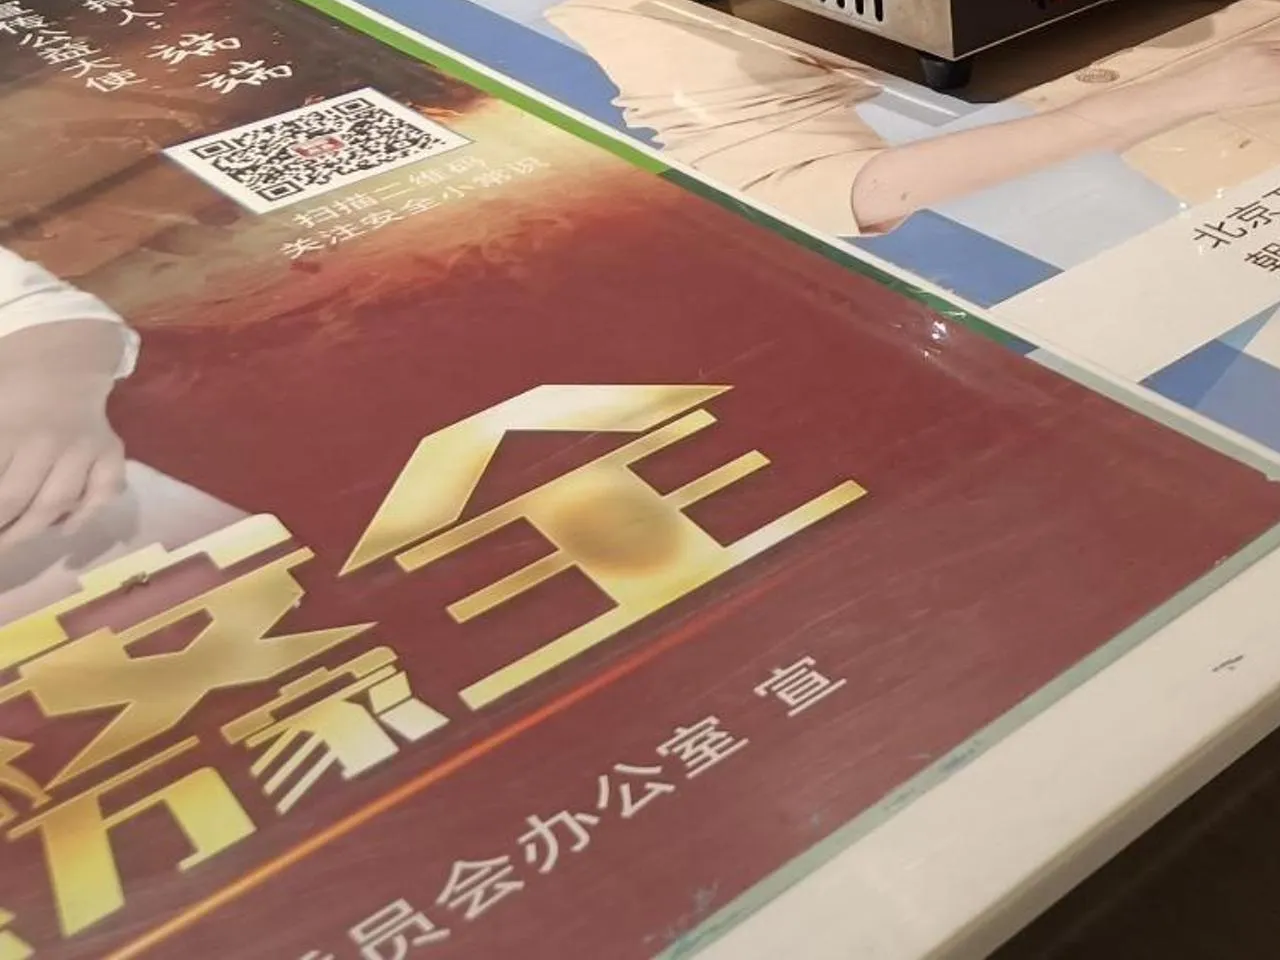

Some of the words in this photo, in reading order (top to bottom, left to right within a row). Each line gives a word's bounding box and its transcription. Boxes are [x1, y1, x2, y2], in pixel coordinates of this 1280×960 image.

[292, 155, 488, 229] 扫描二维码
[0, 383, 868, 825] 安全
[299, 714, 750, 960] 员会办公室
[753, 654, 848, 718] 宣
